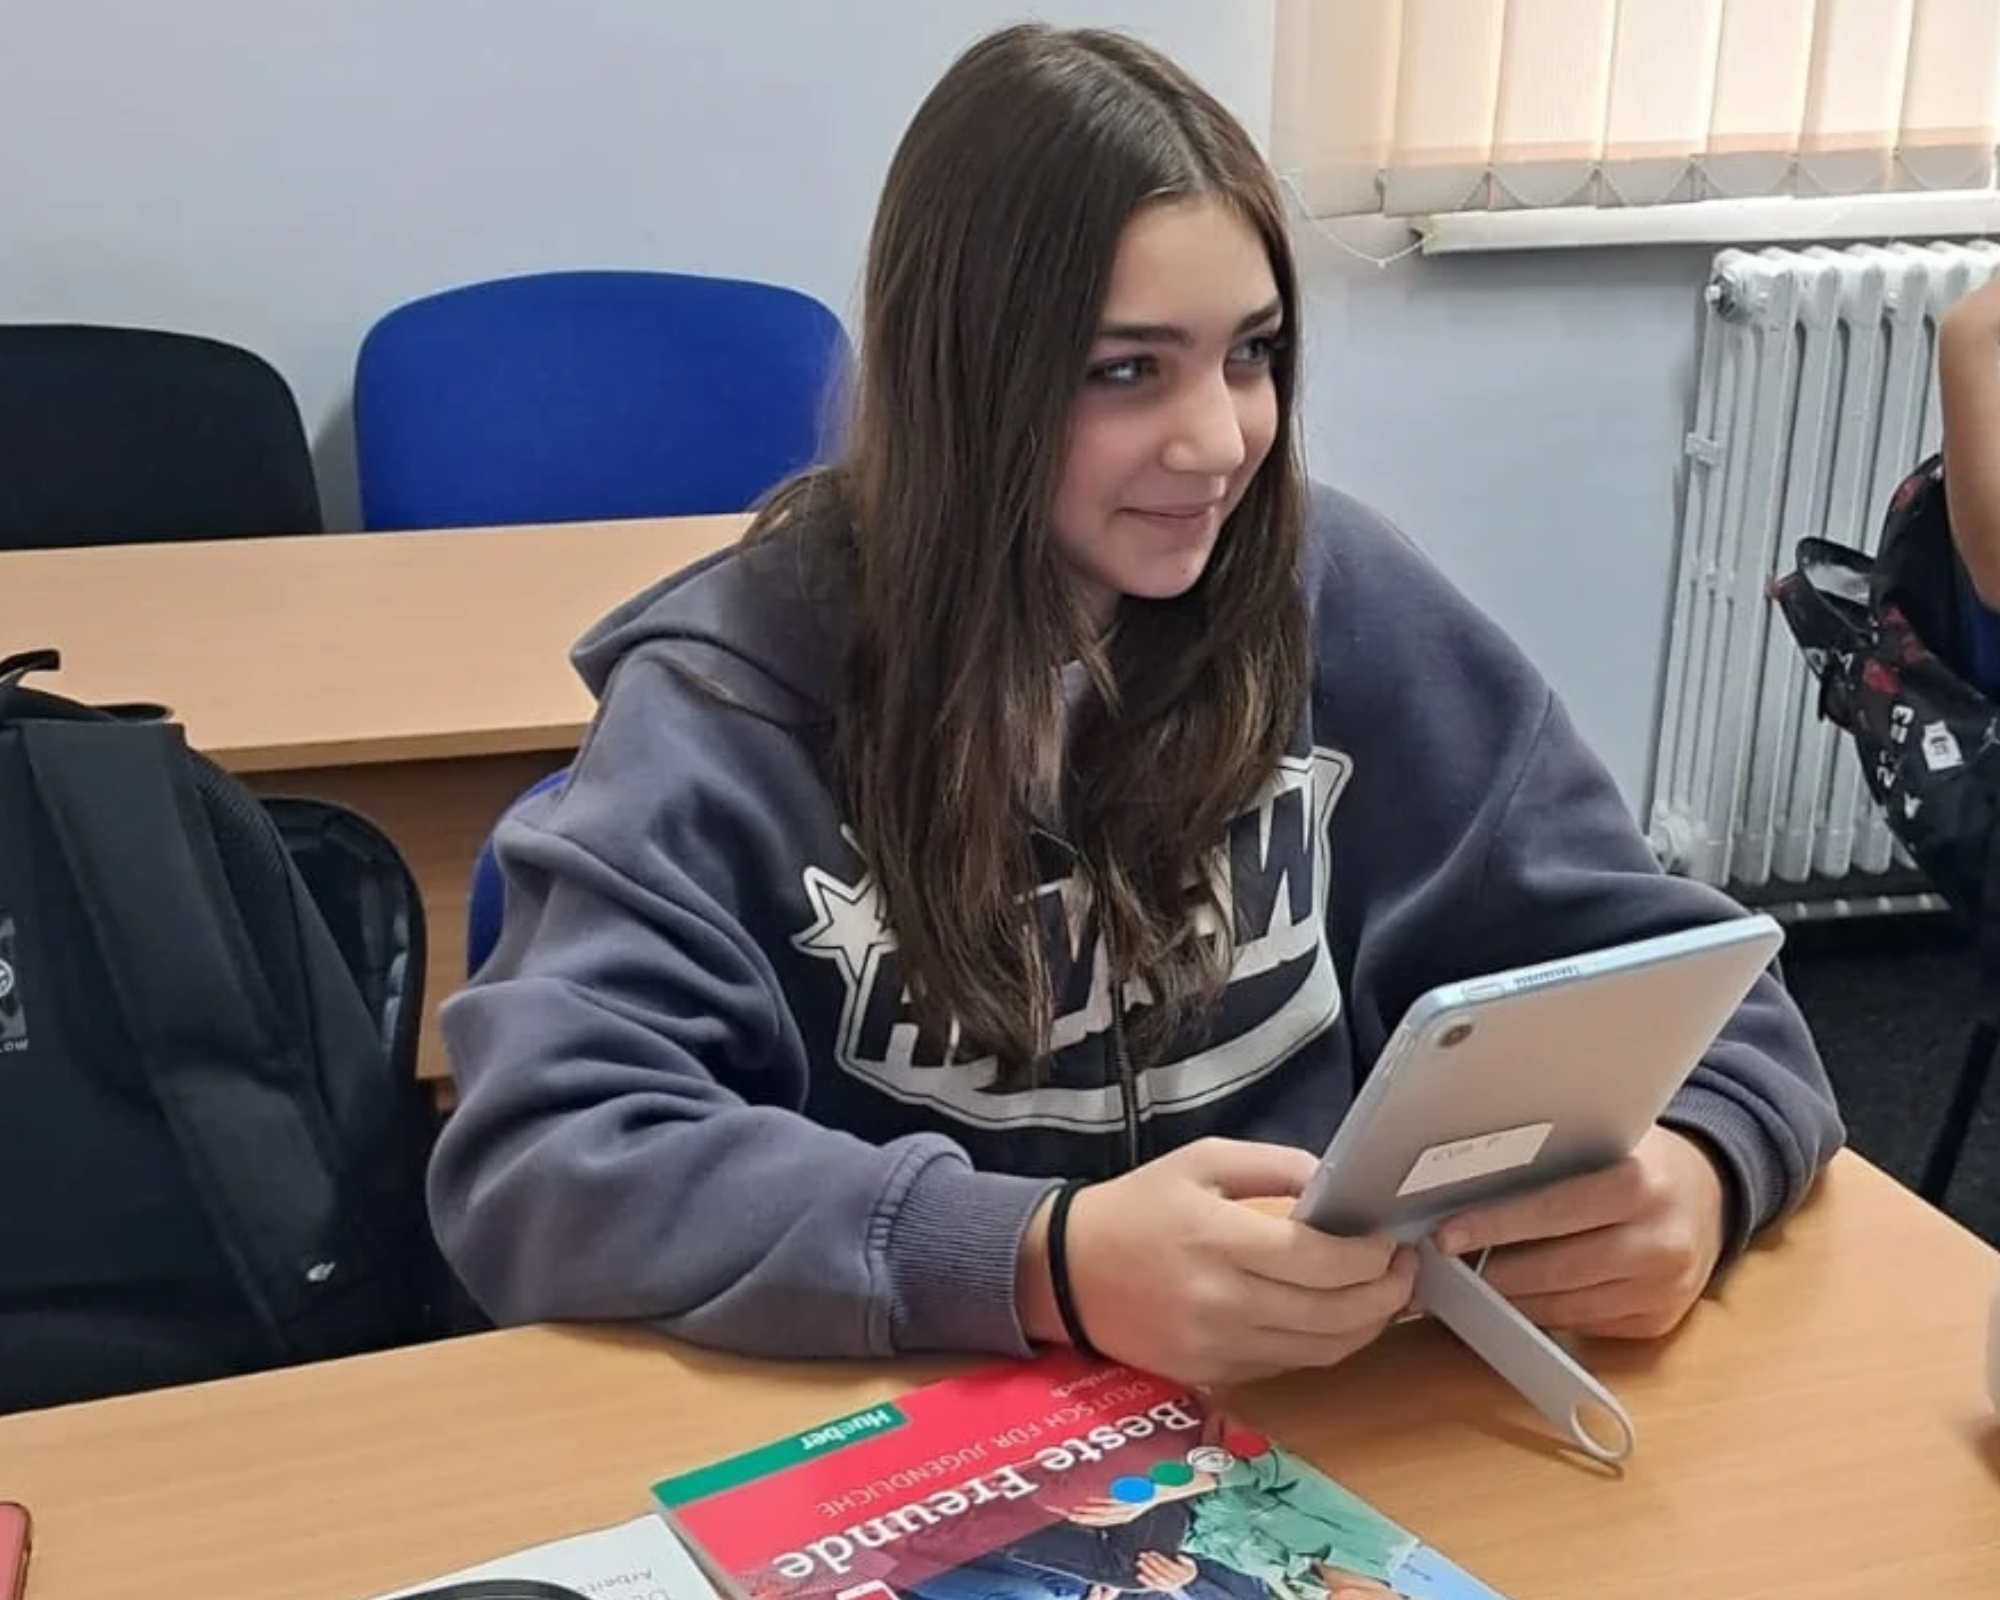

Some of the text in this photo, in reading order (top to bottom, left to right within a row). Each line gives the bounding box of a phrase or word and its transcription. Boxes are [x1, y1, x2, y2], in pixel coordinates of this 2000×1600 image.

[0, 1038, 29, 1052] OW
[801, 1408, 893, 1451] Hueber
[815, 1380, 1153, 1519] DEUTSCH FÜR JUGENDLICHE
[772, 1401, 1201, 1579] Beste Freunde
